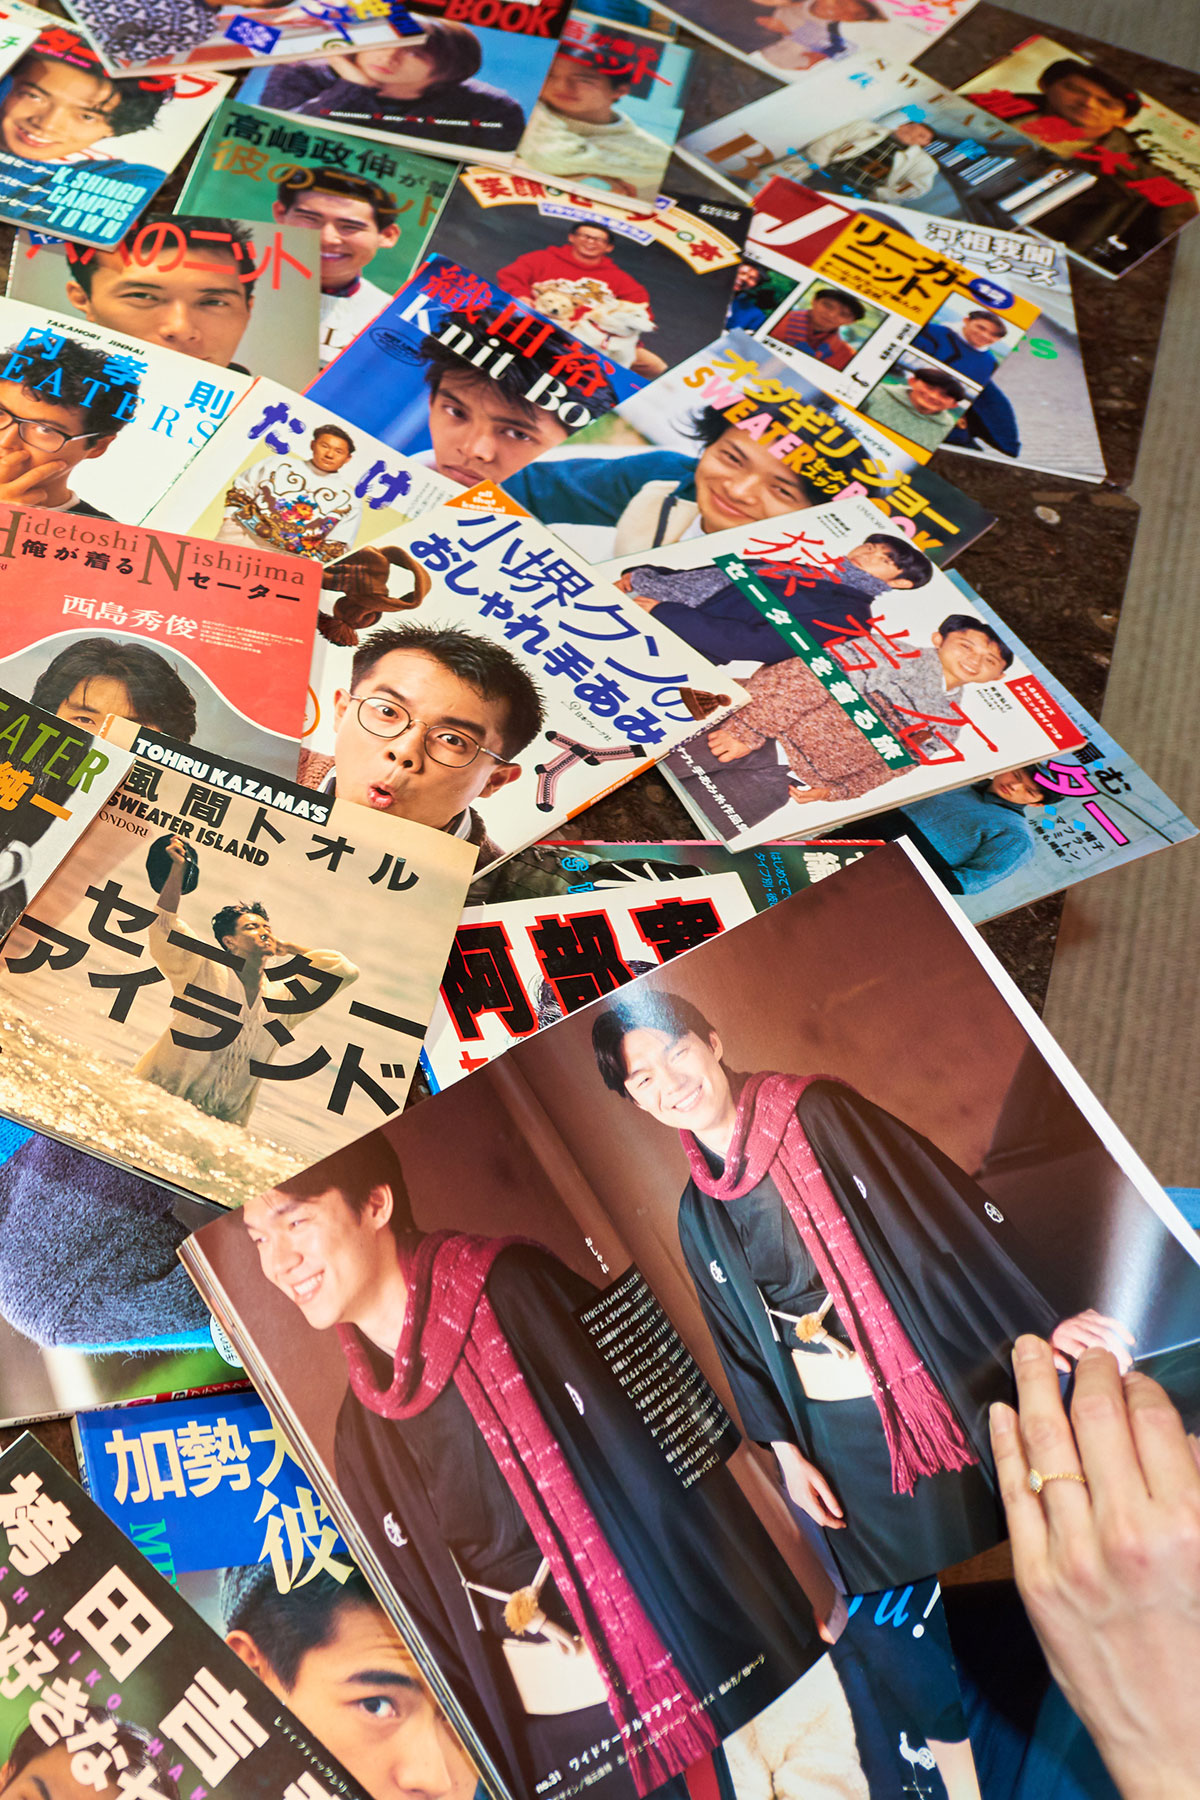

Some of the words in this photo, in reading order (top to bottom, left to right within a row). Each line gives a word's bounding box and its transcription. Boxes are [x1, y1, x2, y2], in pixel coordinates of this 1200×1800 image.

[47, 185, 135, 222] CAMPUS
[47, 205, 123, 239] TOWN
[51, 165, 148, 203] K.SHINGO
[46, 318, 102, 342] TAKANORI
[106, 337, 146, 357] JINNAI
[398, 293, 516, 380] Knit
[420, 265, 617, 398] 織田裕
[682, 365, 818, 475] SWEATER
[711, 347, 961, 537] オダギリジョー
[21, 538, 135, 575] 俺が着る
[187, 572, 302, 603] セーター
[137, 533, 306, 592] Nishijima
[61, 594, 199, 641] 西島秀俊
[409, 531, 668, 745] おしゃれ手あみ
[456, 513, 697, 724] 小堺クンの
[721, 559, 907, 767] セーターを着る旅
[98, 811, 149, 839] ONDORI
[122, 759, 420, 892] 風間トオル
[133, 736, 211, 780] TOHRU
[209, 765, 331, 826] KAZAMA'S
[107, 791, 194, 840] SWEATER
[197, 826, 270, 868] ISLAND
[85, 878, 428, 1042] セーター
[4, 913, 406, 1117] アイランド
[252, 1486, 356, 1595] 彼
